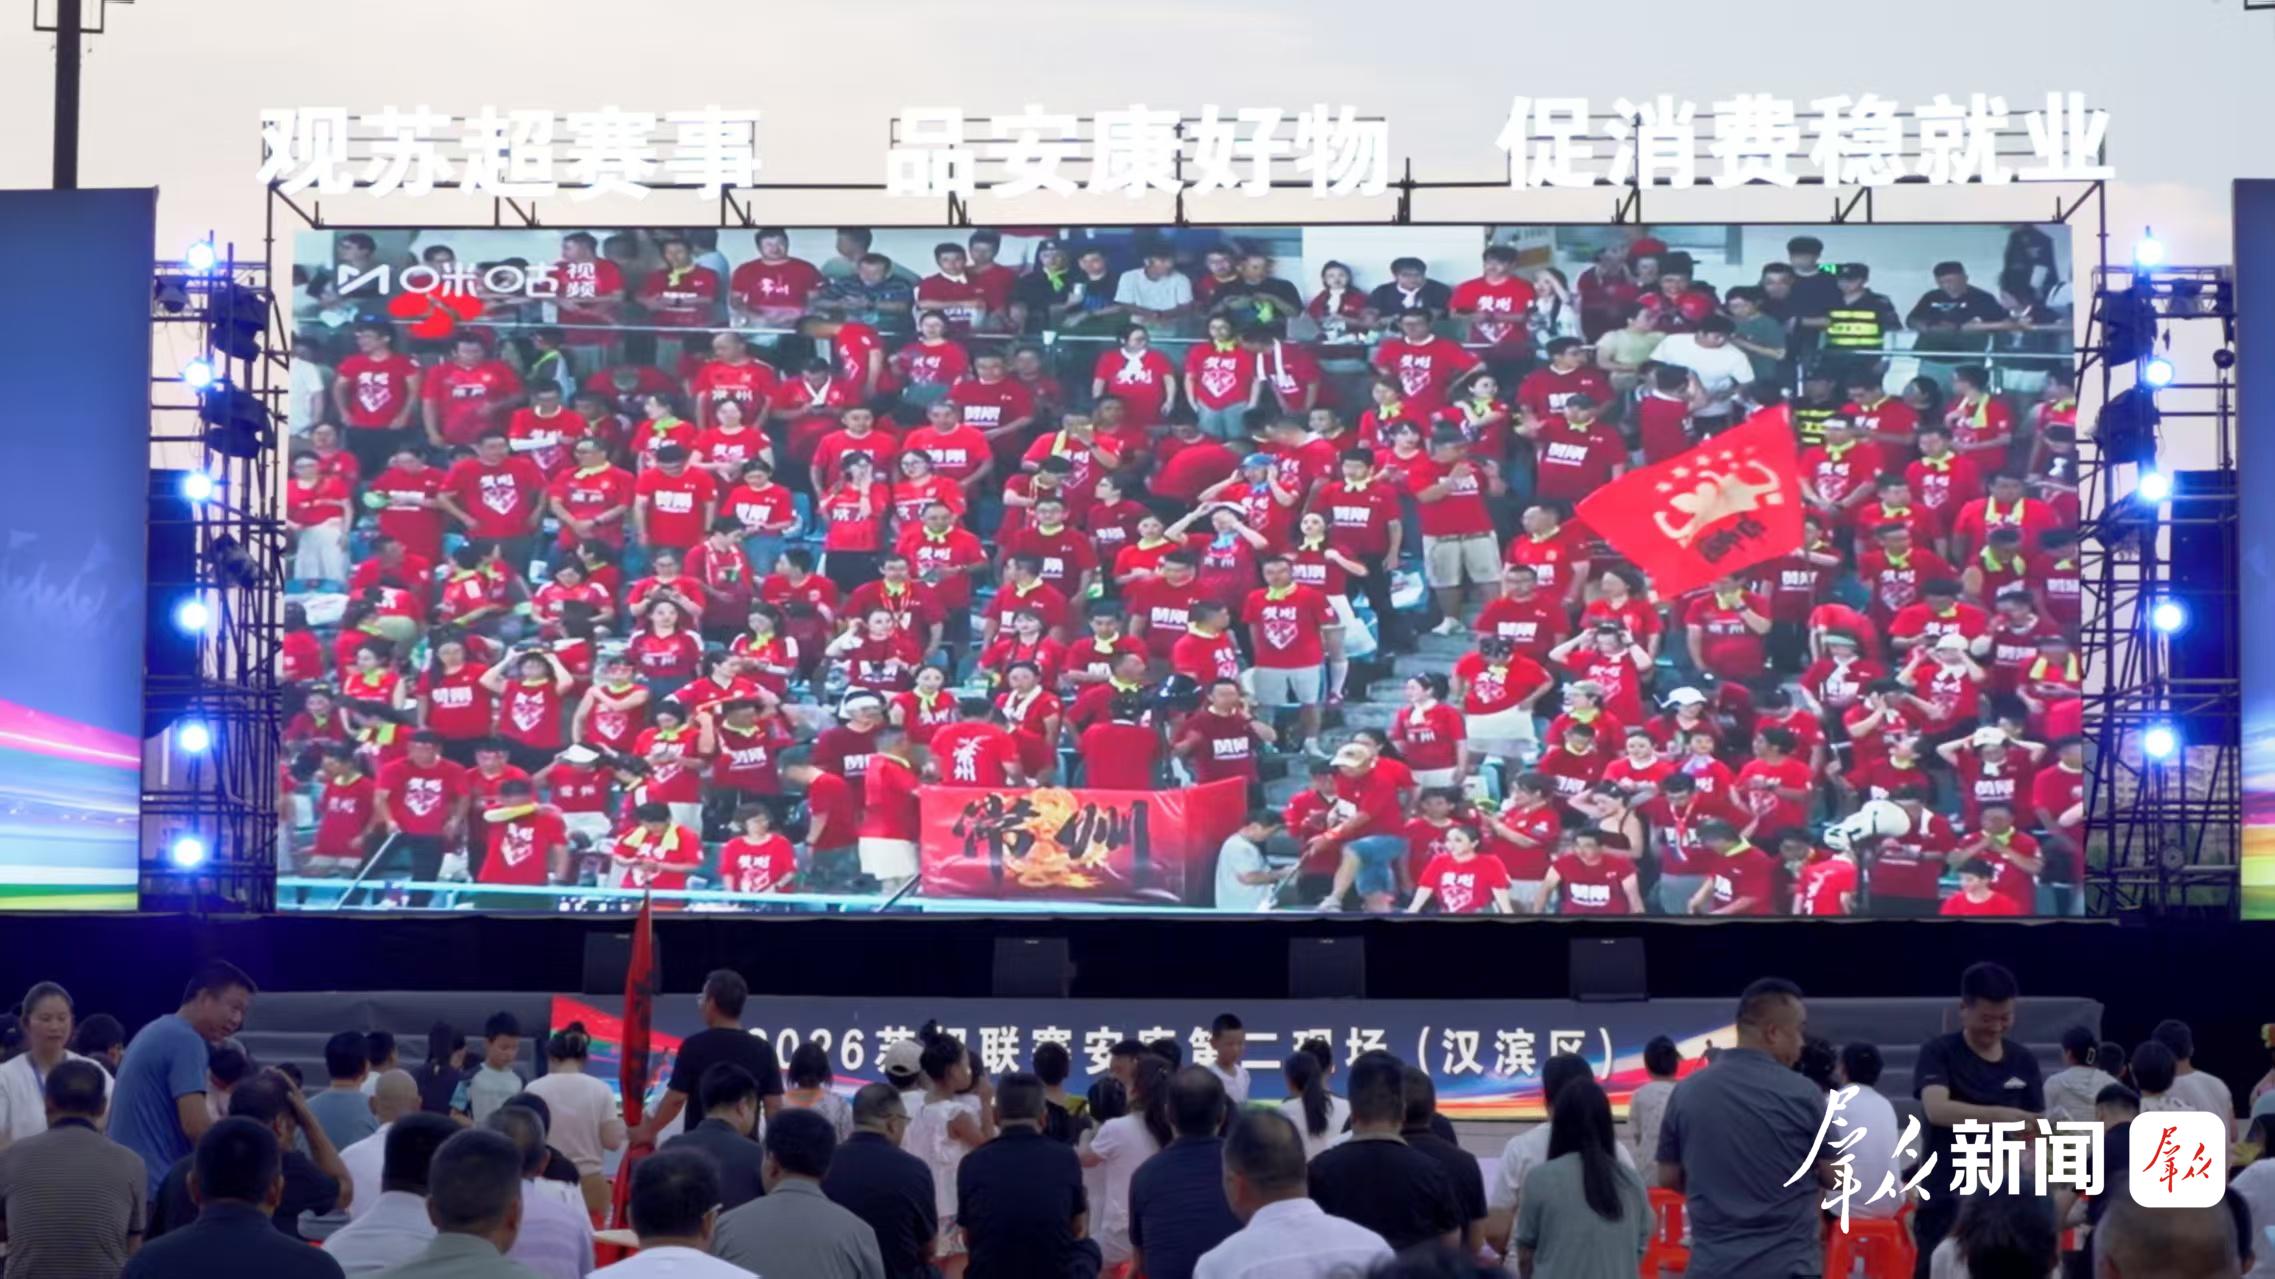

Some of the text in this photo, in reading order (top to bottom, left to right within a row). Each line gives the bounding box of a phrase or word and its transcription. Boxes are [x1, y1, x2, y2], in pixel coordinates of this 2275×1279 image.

[256, 91, 2116, 200] 观苏超赛事 品安康好物 促消费稳就业
